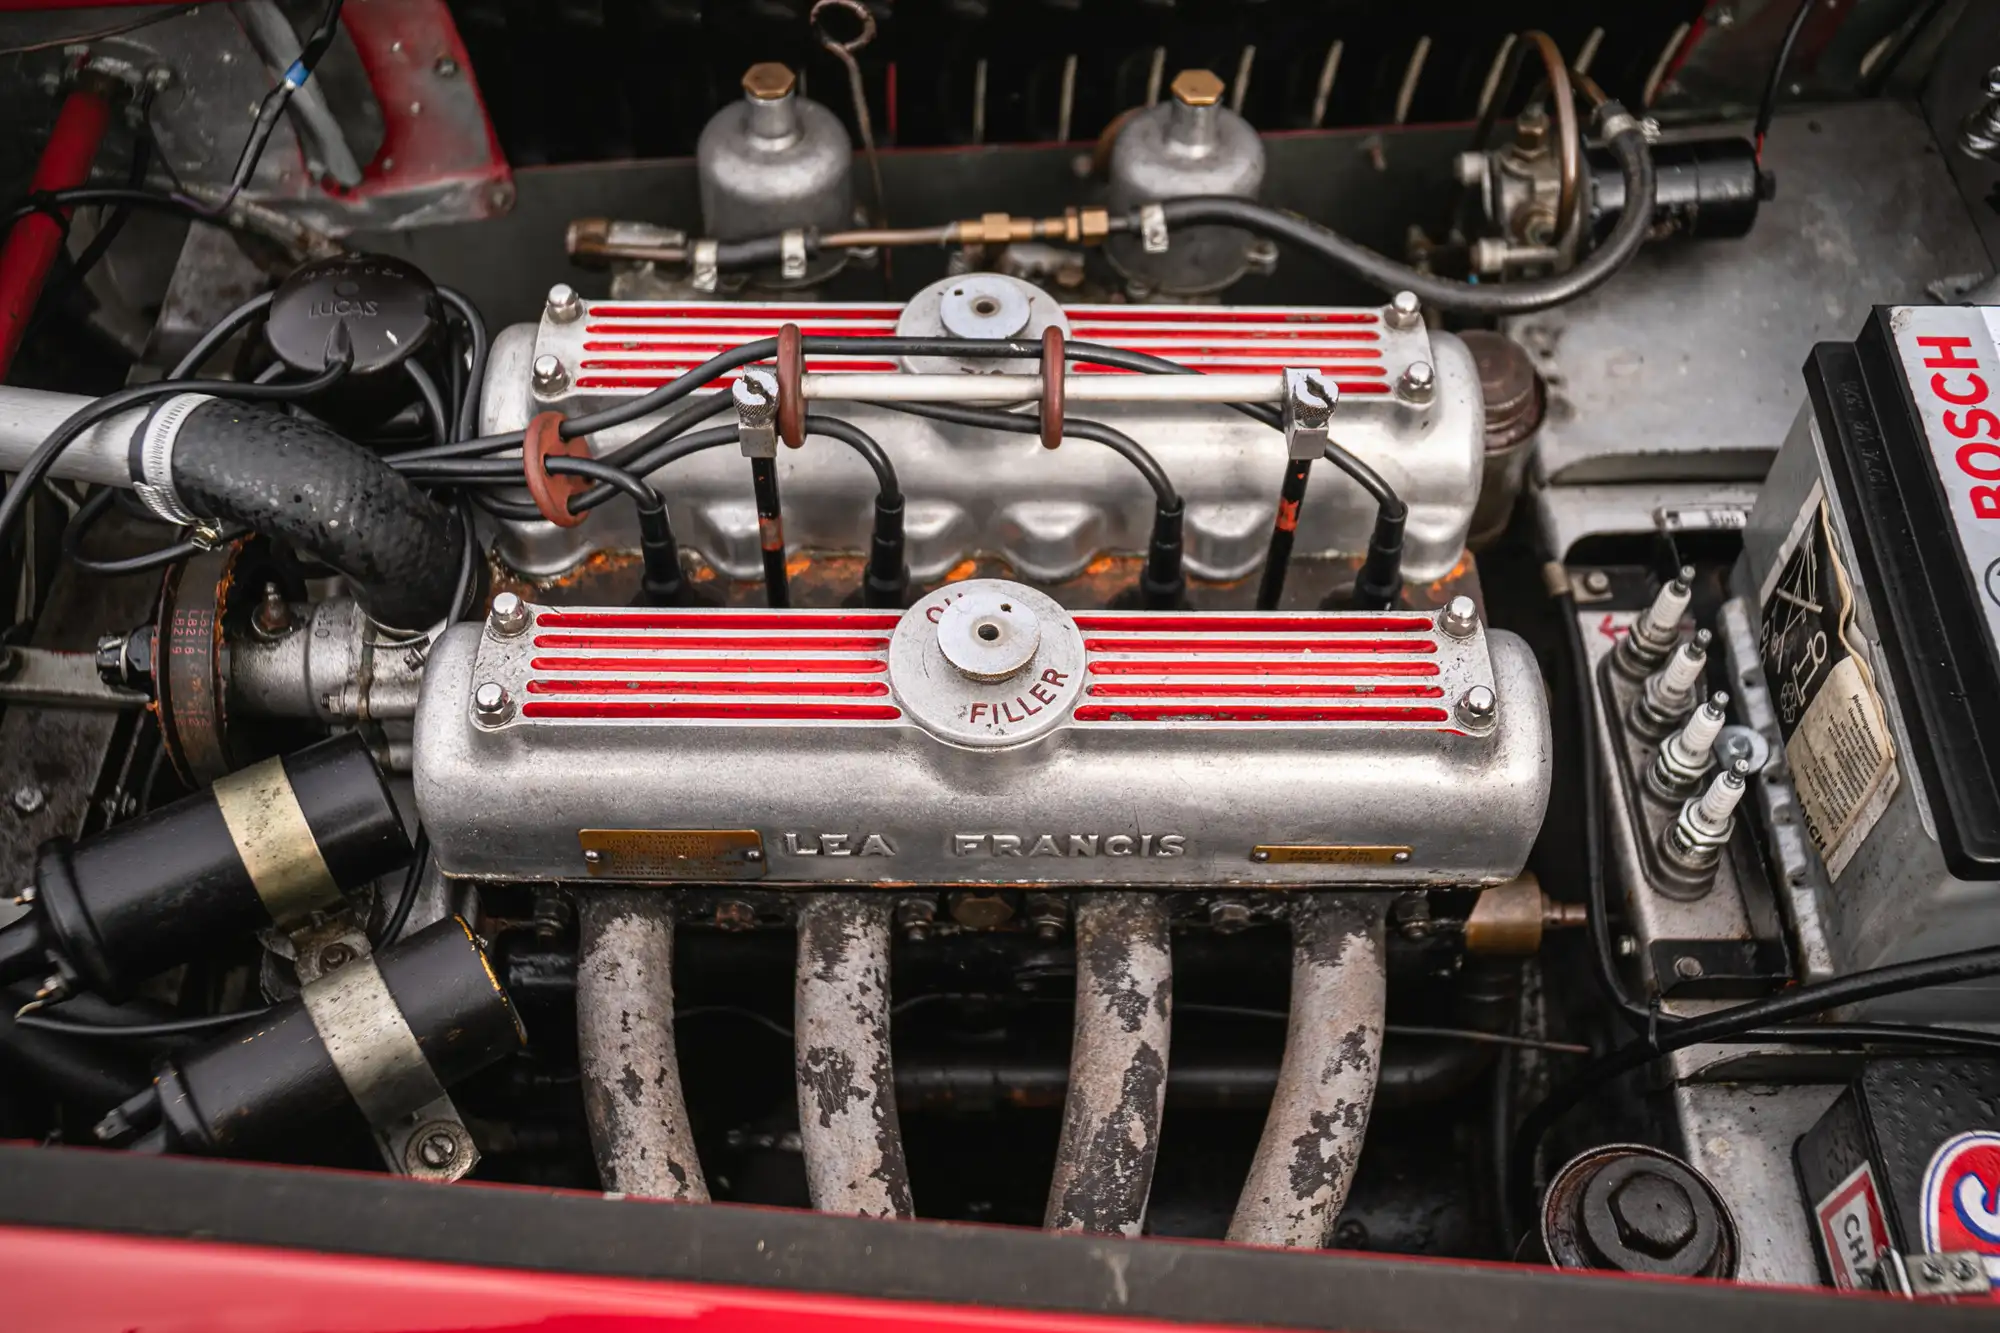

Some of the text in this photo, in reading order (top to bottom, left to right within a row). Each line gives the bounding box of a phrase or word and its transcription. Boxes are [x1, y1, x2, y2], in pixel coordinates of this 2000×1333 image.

[309, 300, 379, 318] LUCAS
[925, 592, 965, 624] OI
[969, 668, 1069, 725] FILLER
[783, 832, 1187, 858] LEA FRANCIS
